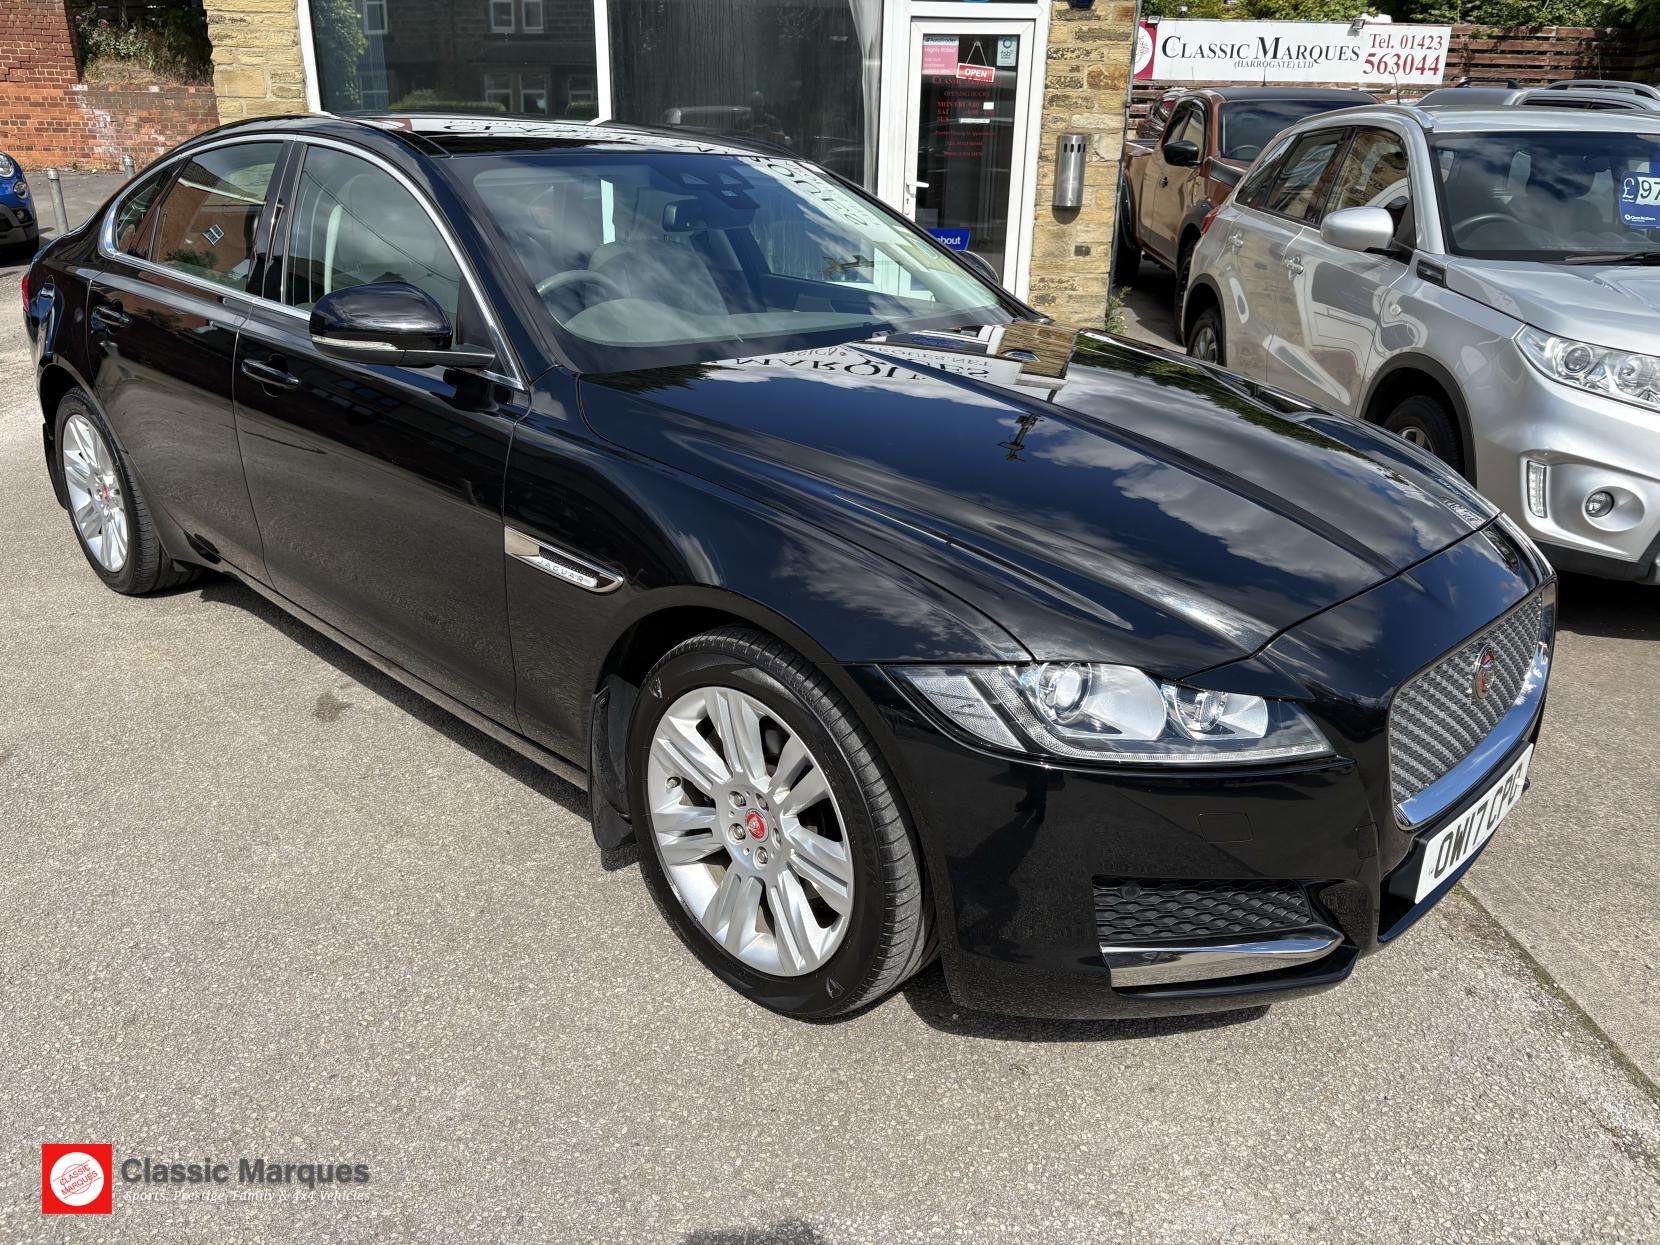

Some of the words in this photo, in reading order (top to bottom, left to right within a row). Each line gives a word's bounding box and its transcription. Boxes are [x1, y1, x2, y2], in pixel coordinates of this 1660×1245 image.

[1253, 36, 1361, 64] MARQUES
[1370, 33, 1395, 49] Tel.
[1400, 34, 1443, 50] 01423
[964, 68, 988, 78] OPEN
[1233, 59, 1296, 70] (HARROGATE)
[1297, 60, 1315, 69] LTD
[1362, 52, 1441, 76] 563044
[537, 560, 584, 582] JAGUAR
